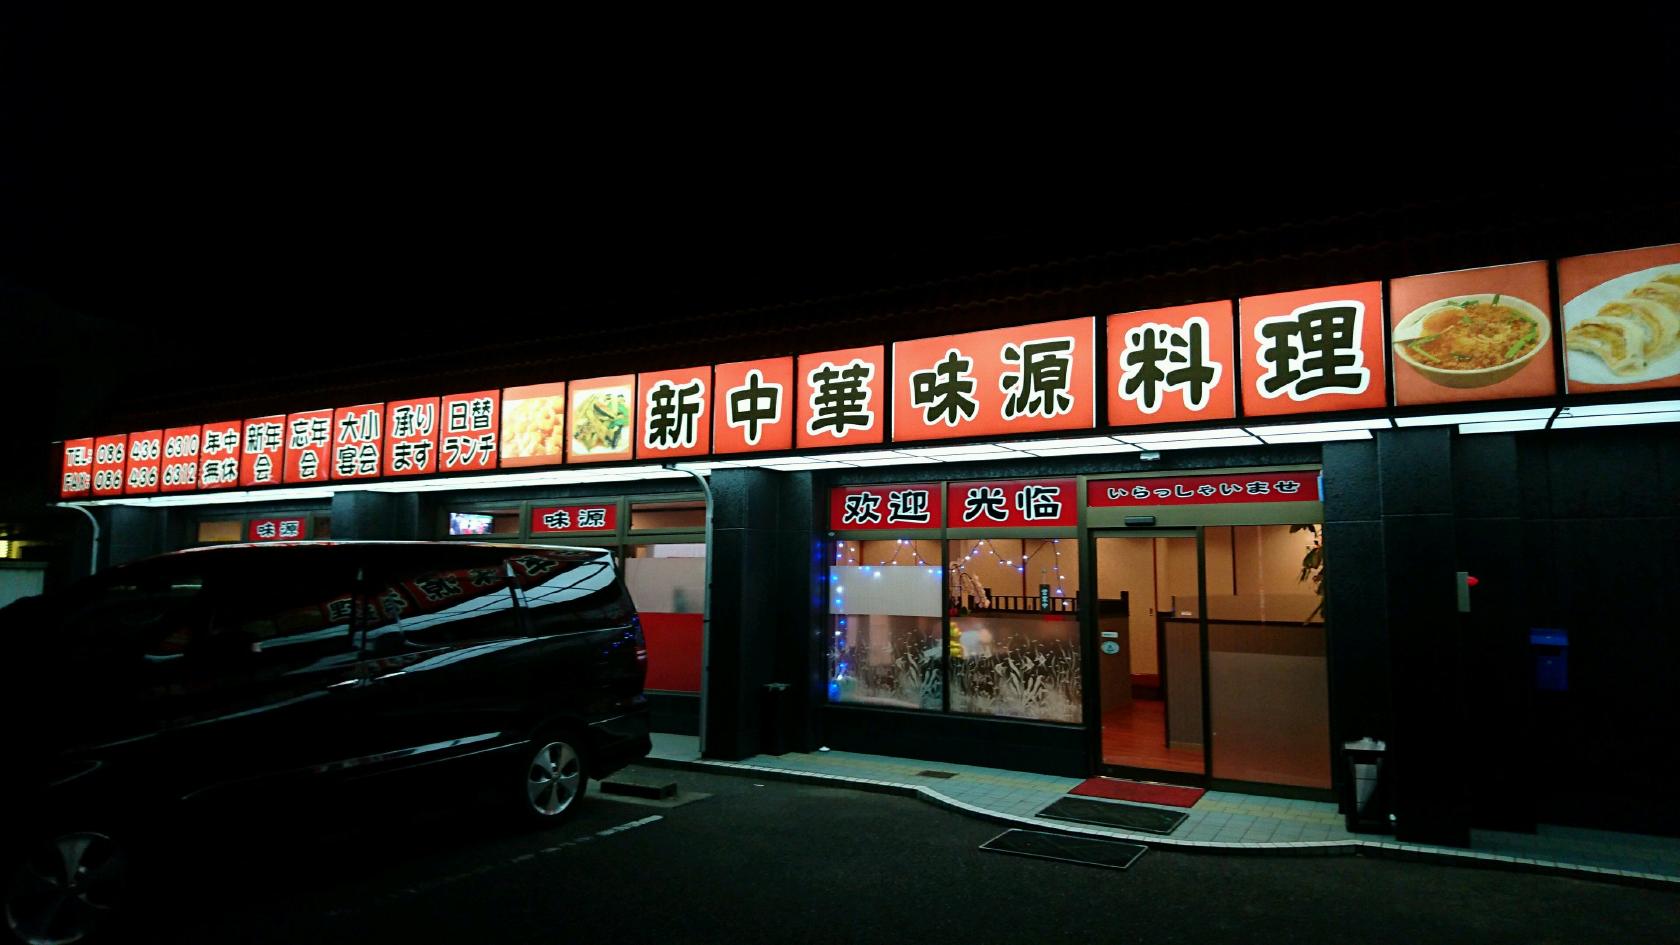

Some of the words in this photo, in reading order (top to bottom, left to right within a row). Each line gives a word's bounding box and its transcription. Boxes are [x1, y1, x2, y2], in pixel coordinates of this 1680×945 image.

[339, 409, 380, 443] 大小
[392, 402, 435, 438] 承り
[447, 397, 493, 433] 日替
[205, 428, 240, 454] 年中
[246, 422, 283, 453] 新年
[291, 418, 328, 449] 忘年
[66, 446, 92, 466] TEL:
[97, 443, 124, 463] 086
[131, 439, 160, 461] 436
[165, 434, 199, 457] 6310
[299, 451, 317, 479] 会
[337, 443, 380, 475] 宴会
[392, 440, 432, 471] ます
[444, 433, 496, 469] ランチ
[94, 469, 122, 490] 086
[128, 466, 157, 488] 436
[162, 462, 197, 485] 6312
[202, 457, 239, 484] 無休
[254, 453, 272, 482] 会
[1106, 479, 1303, 500] いらっしゃいませ
[543, 508, 607, 529] 味源
[842, 490, 931, 525] 欢迎
[962, 486, 1062, 522] 光临
[256, 520, 300, 537] 味源
